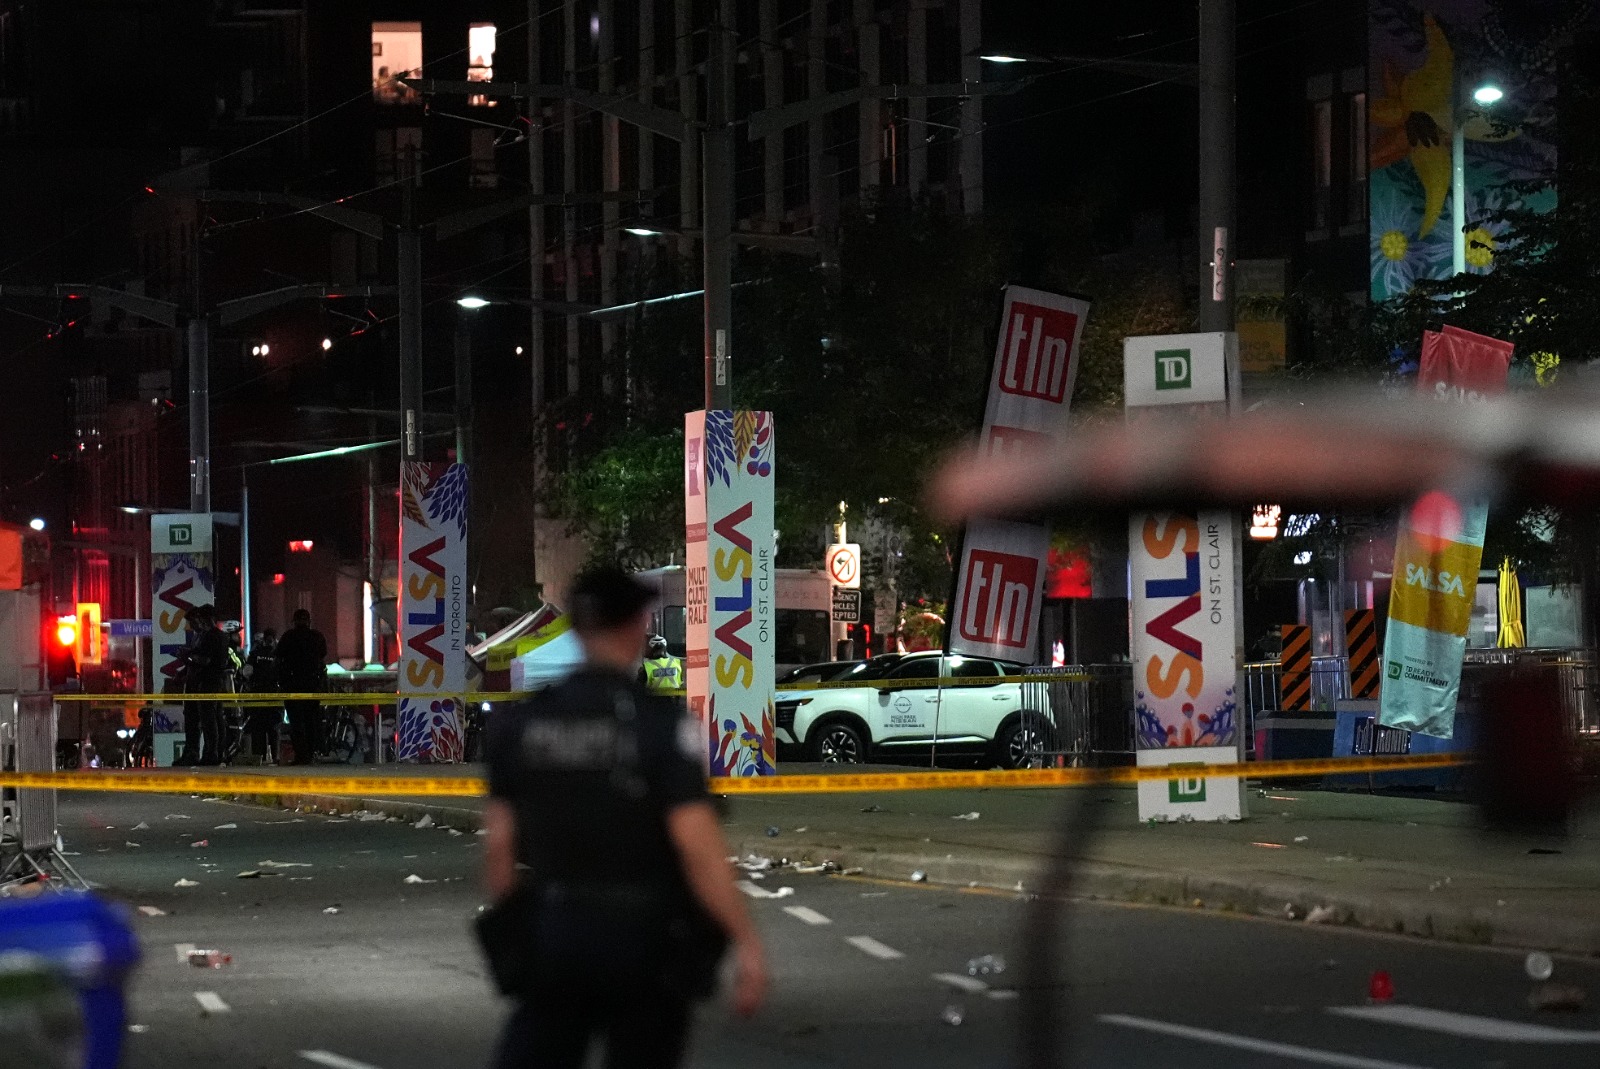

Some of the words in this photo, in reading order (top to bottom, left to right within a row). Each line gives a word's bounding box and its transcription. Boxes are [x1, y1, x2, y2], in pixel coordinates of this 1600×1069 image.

[1158, 356, 1189, 385] TD
[171, 527, 190, 542] TD
[1208, 524, 1220, 570] CLAIR
[688, 566, 708, 587] MULTI
[759, 548, 769, 591] CLAIR
[1406, 562, 1465, 598] SALSA
[688, 586, 708, 605] CULTU
[713, 501, 753, 690] SALSA
[1210, 574, 1221, 594] ST.
[407, 536, 446, 689] SALSA
[451, 575, 461, 636] TORONTO
[759, 595, 769, 616] ST.
[963, 560, 1029, 642] tln
[1144, 512, 1204, 700] SALS
[1210, 597, 1222, 625] ON
[451, 637, 460, 652] IN
[759, 624, 769, 643] ON
[1405, 672, 1449, 687] COMMITMENT
[1414, 667, 1435, 677] READY
